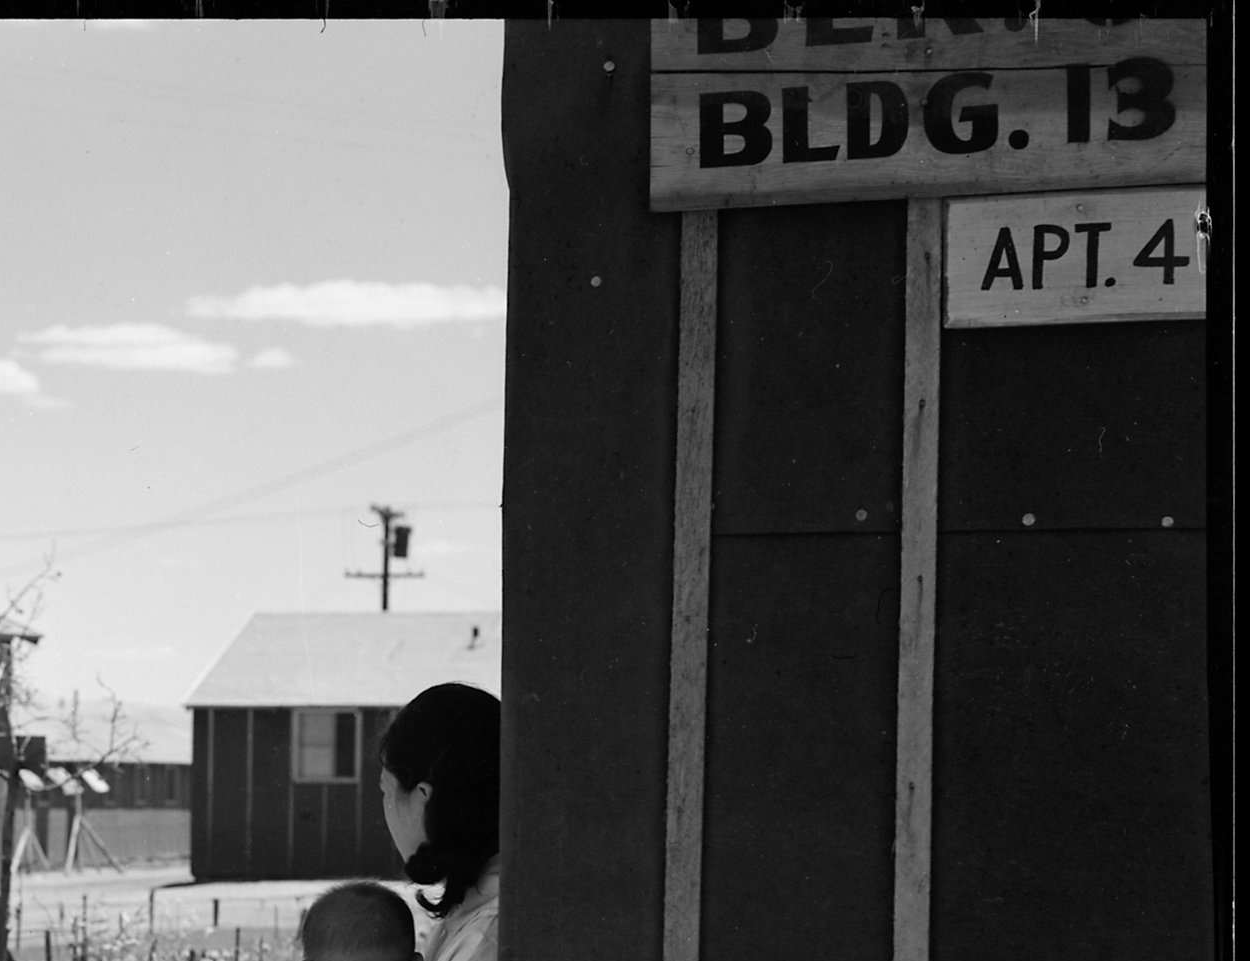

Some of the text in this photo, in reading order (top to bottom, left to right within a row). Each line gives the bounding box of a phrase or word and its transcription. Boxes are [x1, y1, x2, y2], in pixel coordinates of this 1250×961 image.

[698, 55, 1177, 169] BLDG. 13
[980, 217, 1190, 291] APT. 4
